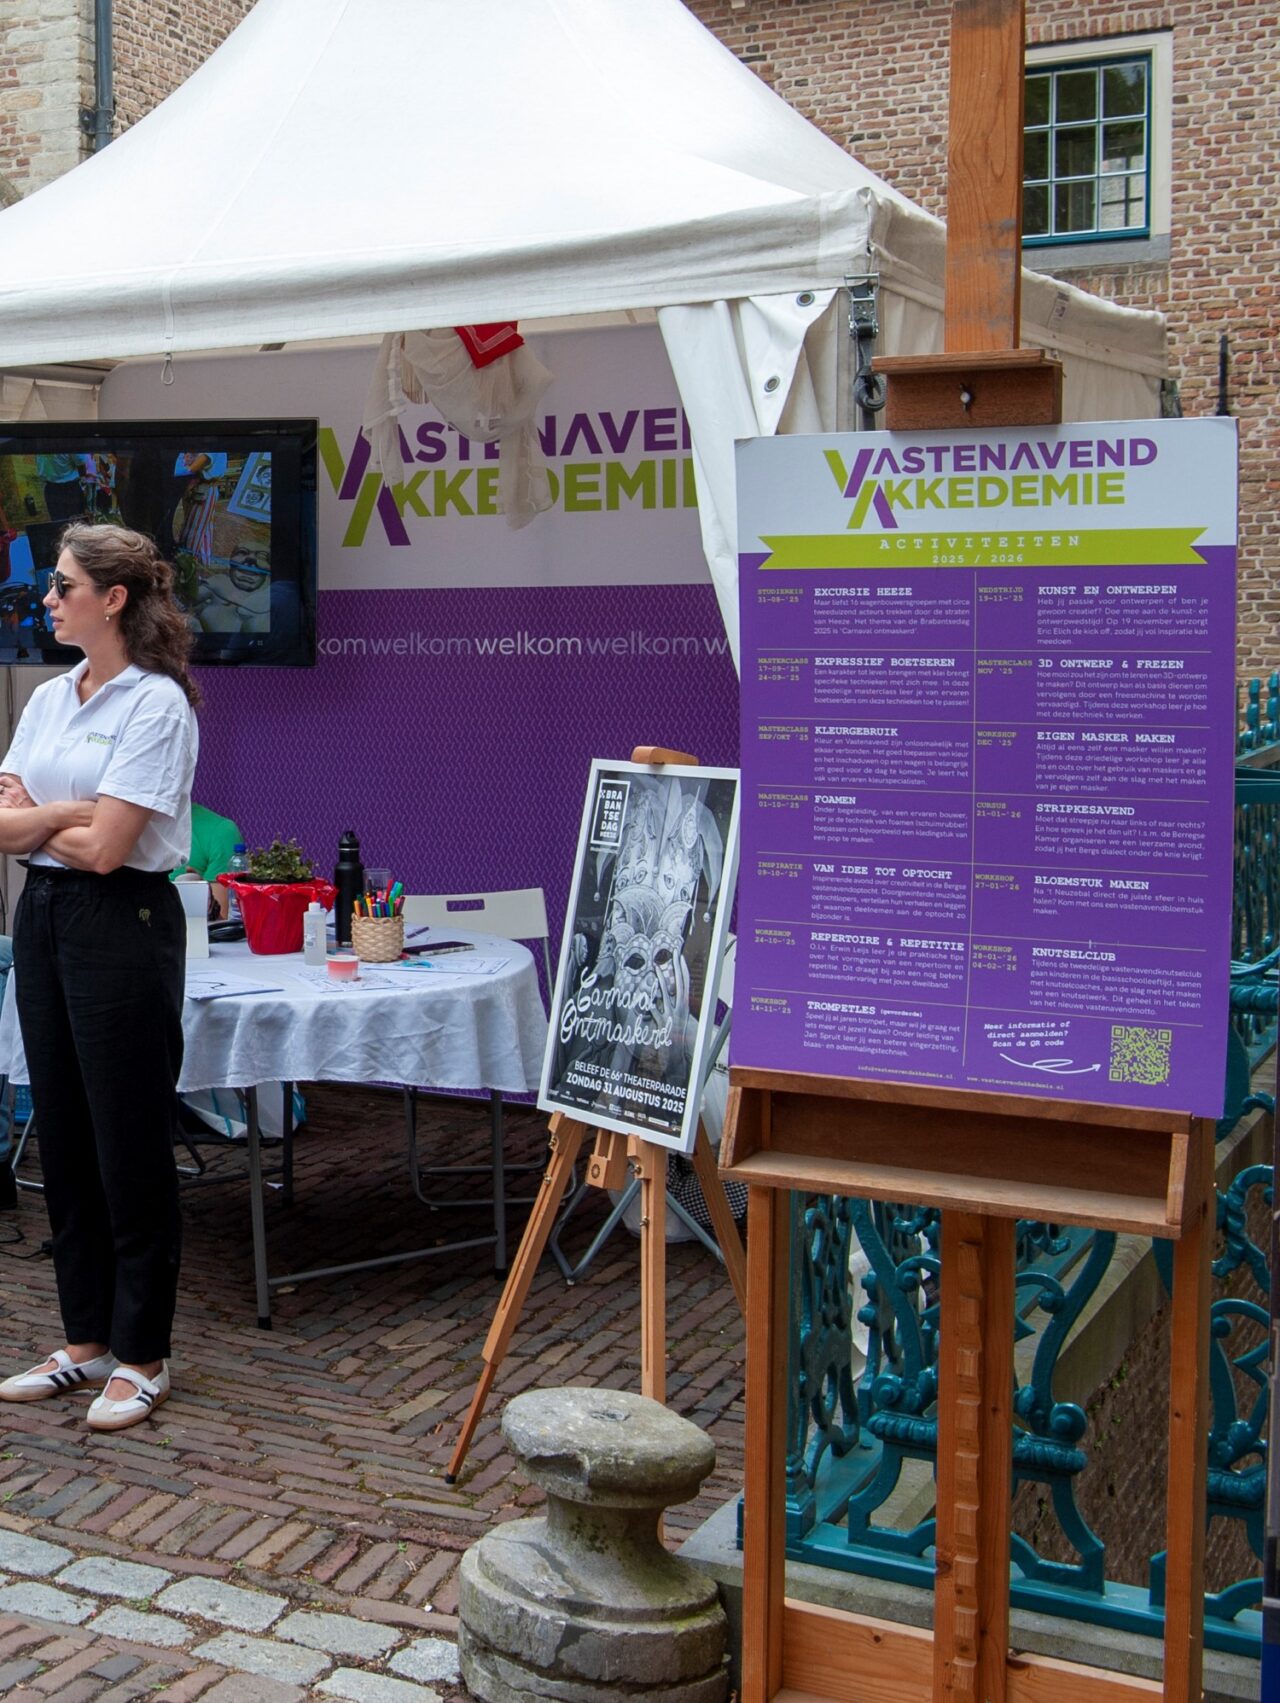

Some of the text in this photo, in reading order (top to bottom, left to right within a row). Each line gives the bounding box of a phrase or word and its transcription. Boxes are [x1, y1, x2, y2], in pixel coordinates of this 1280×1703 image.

[879, 536, 1080, 549] ACTIVITEITEN
[932, 556, 965, 564] 2025
[814, 587, 912, 596] EXCURSIE HEEZE
[1038, 585, 1176, 595] KUNST EN ONTWERPEN
[814, 657, 955, 667] EXPRESSIEF BOETSEREN
[1038, 658, 1184, 669] 3D ONTWERP & FREZEN
[815, 726, 898, 736] KLEURGEBRUIK
[1037, 731, 1175, 743] EIGEN MASKER MAKEN
[606, 790, 623, 800] BRA
[814, 794, 856, 804] FOAMEN
[604, 800, 621, 810] BAN
[1036, 803, 1134, 815] STRIPKESAVEND
[603, 811, 620, 820] TSE
[601, 820, 618, 831] DAG
[813, 863, 952, 879] VAN IDEE TOT OPTOCHT
[1034, 875, 1149, 890] BLOEMSTUK MAKEN
[811, 932, 964, 951] REPERTOIRE & REPETITIE
[1032, 947, 1115, 961] KNUTSELCLUB
[578, 966, 658, 1012] Carnaval
[807, 1000, 875, 1015] TROMPETLES
[561, 998, 673, 1049] Ontmaskerd
[1007, 1021, 1056, 1029] informatie
[987, 1031, 1015, 1039] direct
[1029, 1039, 1040, 1047] QR
[574, 1060, 600, 1074] BELEEF
[600, 1067, 611, 1078] DE
[624, 1073, 687, 1099] THEATERPARADE
[566, 1072, 685, 1114] ZONDAG 31 AUGUSTUS 2025
